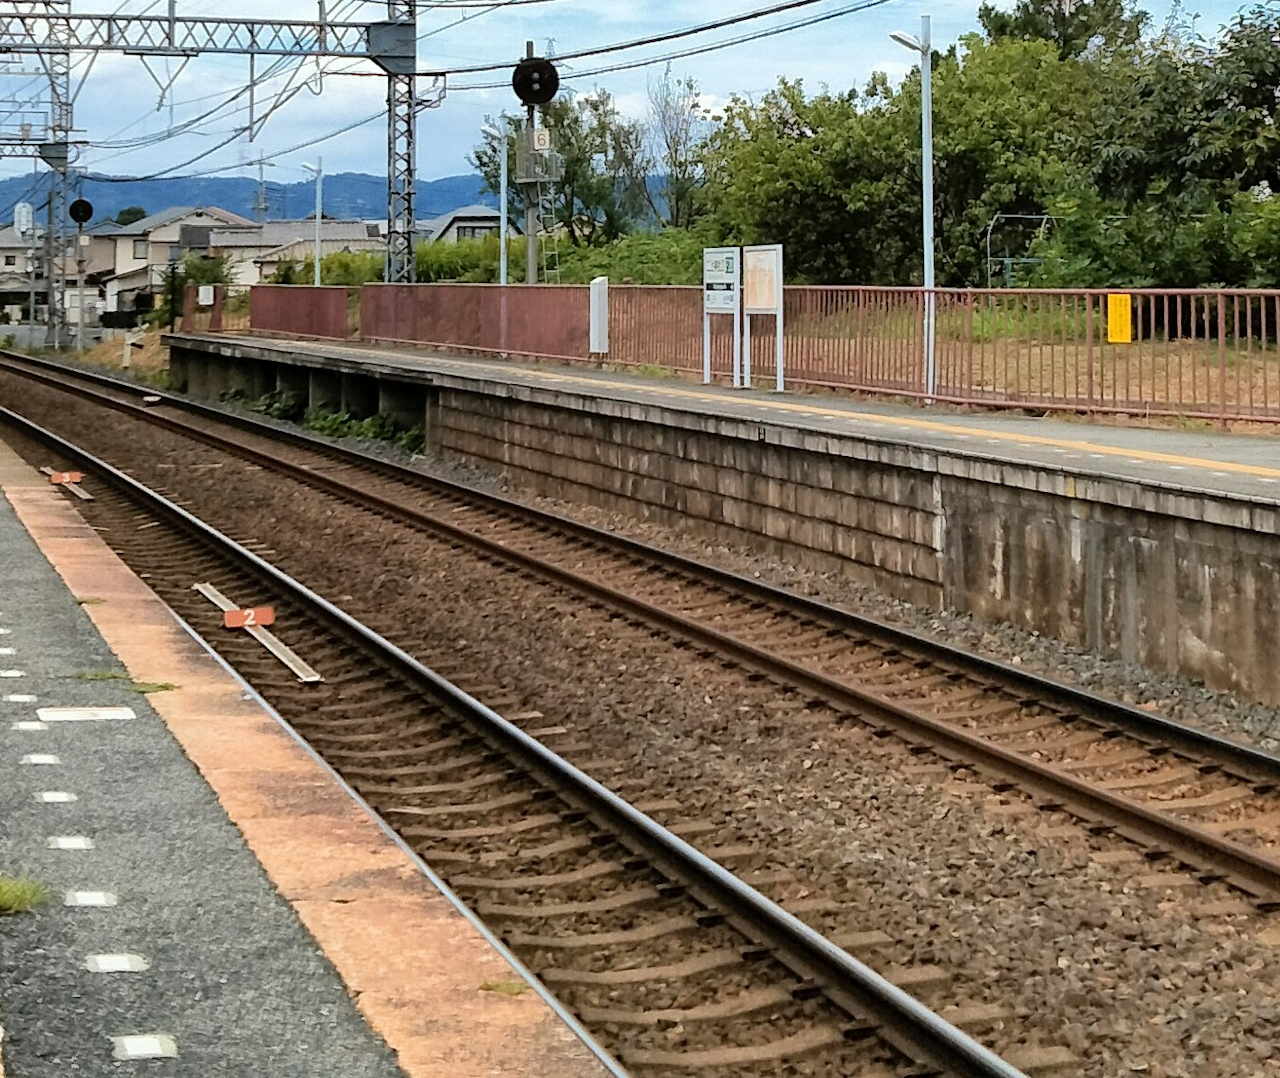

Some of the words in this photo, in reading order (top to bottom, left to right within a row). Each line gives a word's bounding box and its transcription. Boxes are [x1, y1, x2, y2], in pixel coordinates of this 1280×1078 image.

[537, 133, 546, 147] 6
[62, 472, 70, 482] 3
[243, 609, 256, 625] 2
